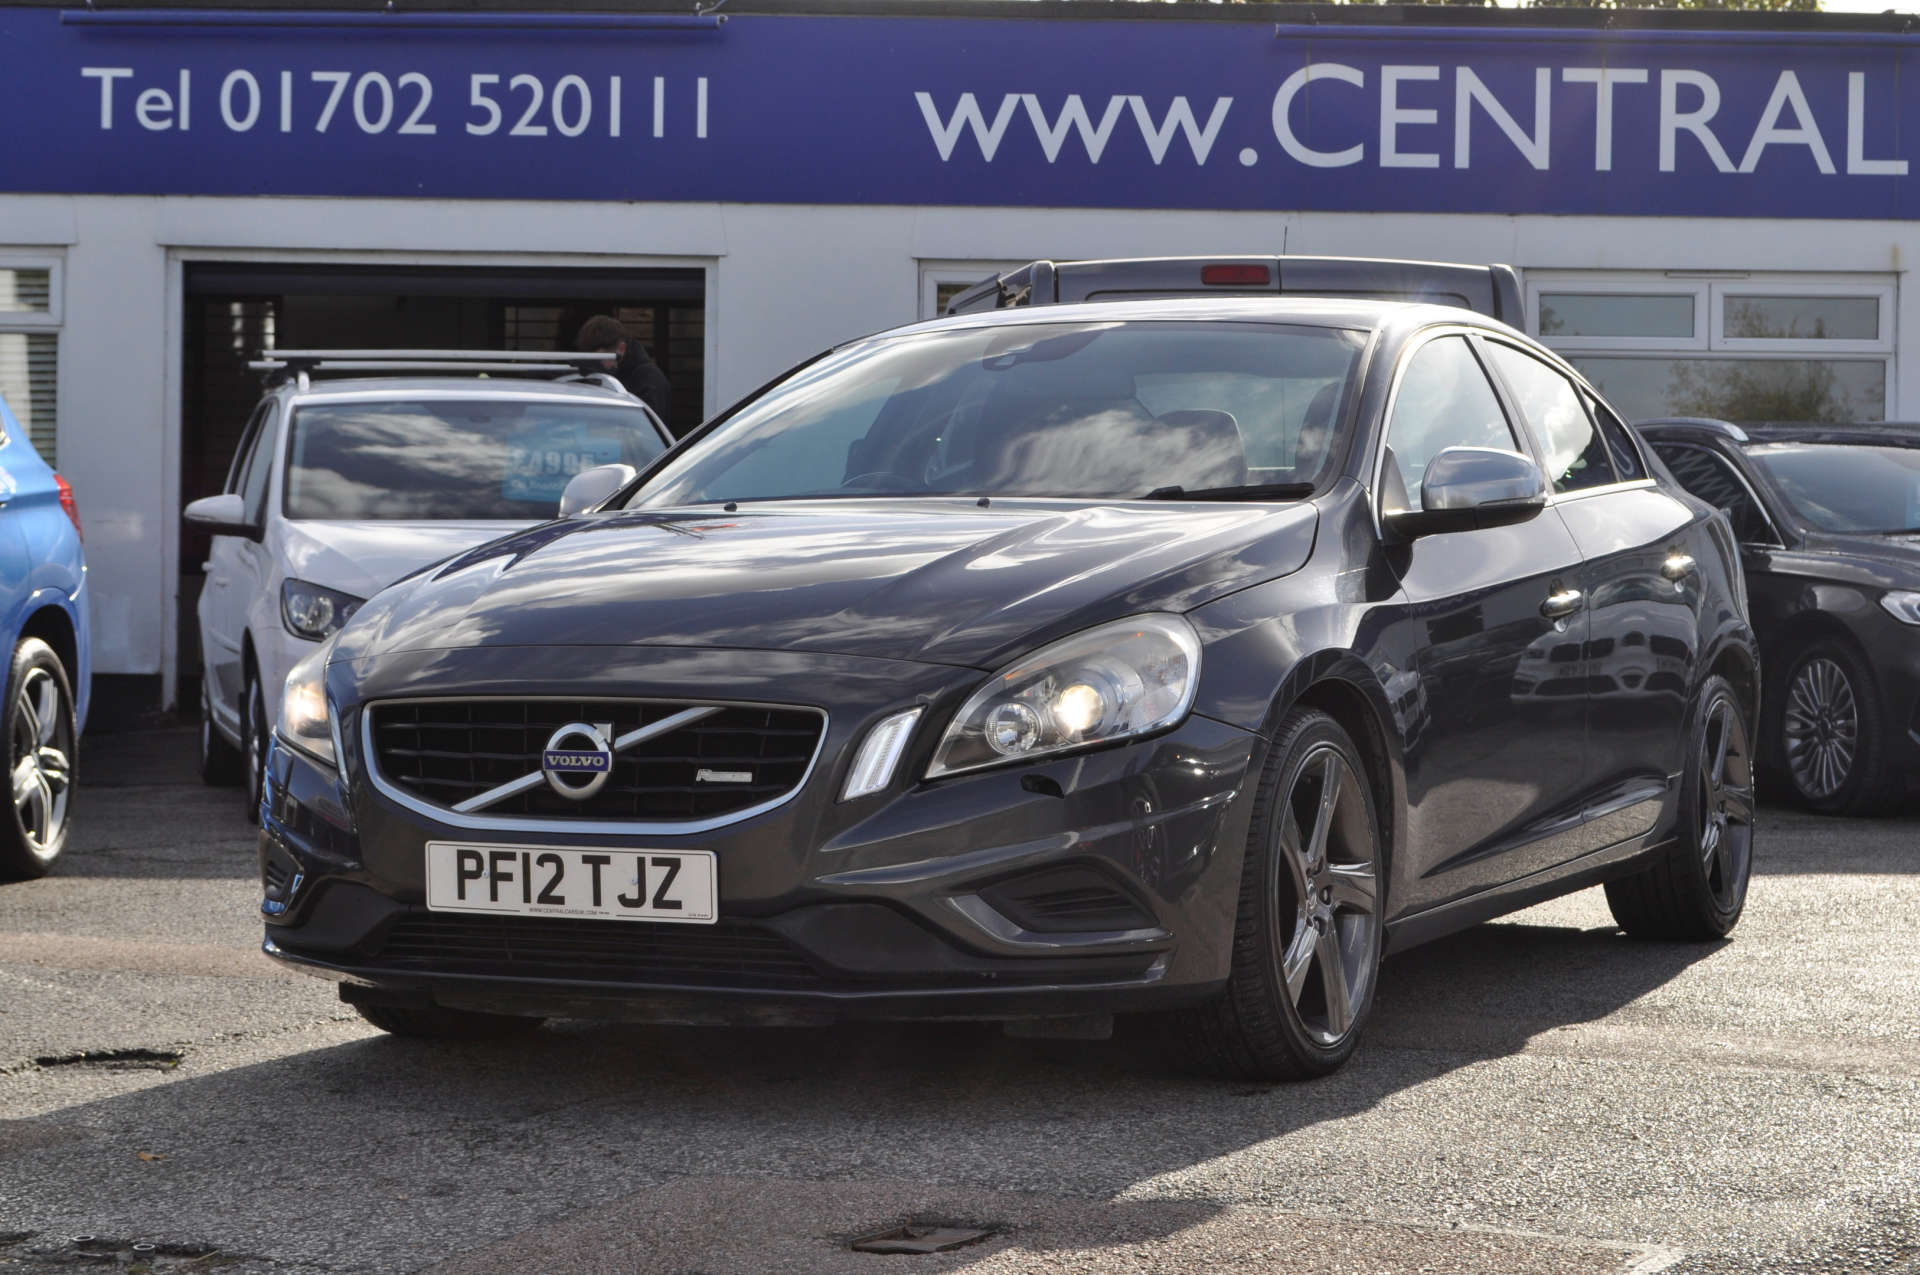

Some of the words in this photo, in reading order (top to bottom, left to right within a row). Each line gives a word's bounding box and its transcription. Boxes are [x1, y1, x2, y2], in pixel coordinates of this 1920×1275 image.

[81, 67, 191, 131] Tel
[219, 69, 437, 135] 01702
[465, 74, 709, 139] 520111
[547, 755, 605, 768] VOLVO
[456, 848, 566, 905] PF12
[581, 854, 683, 910] TJZ
